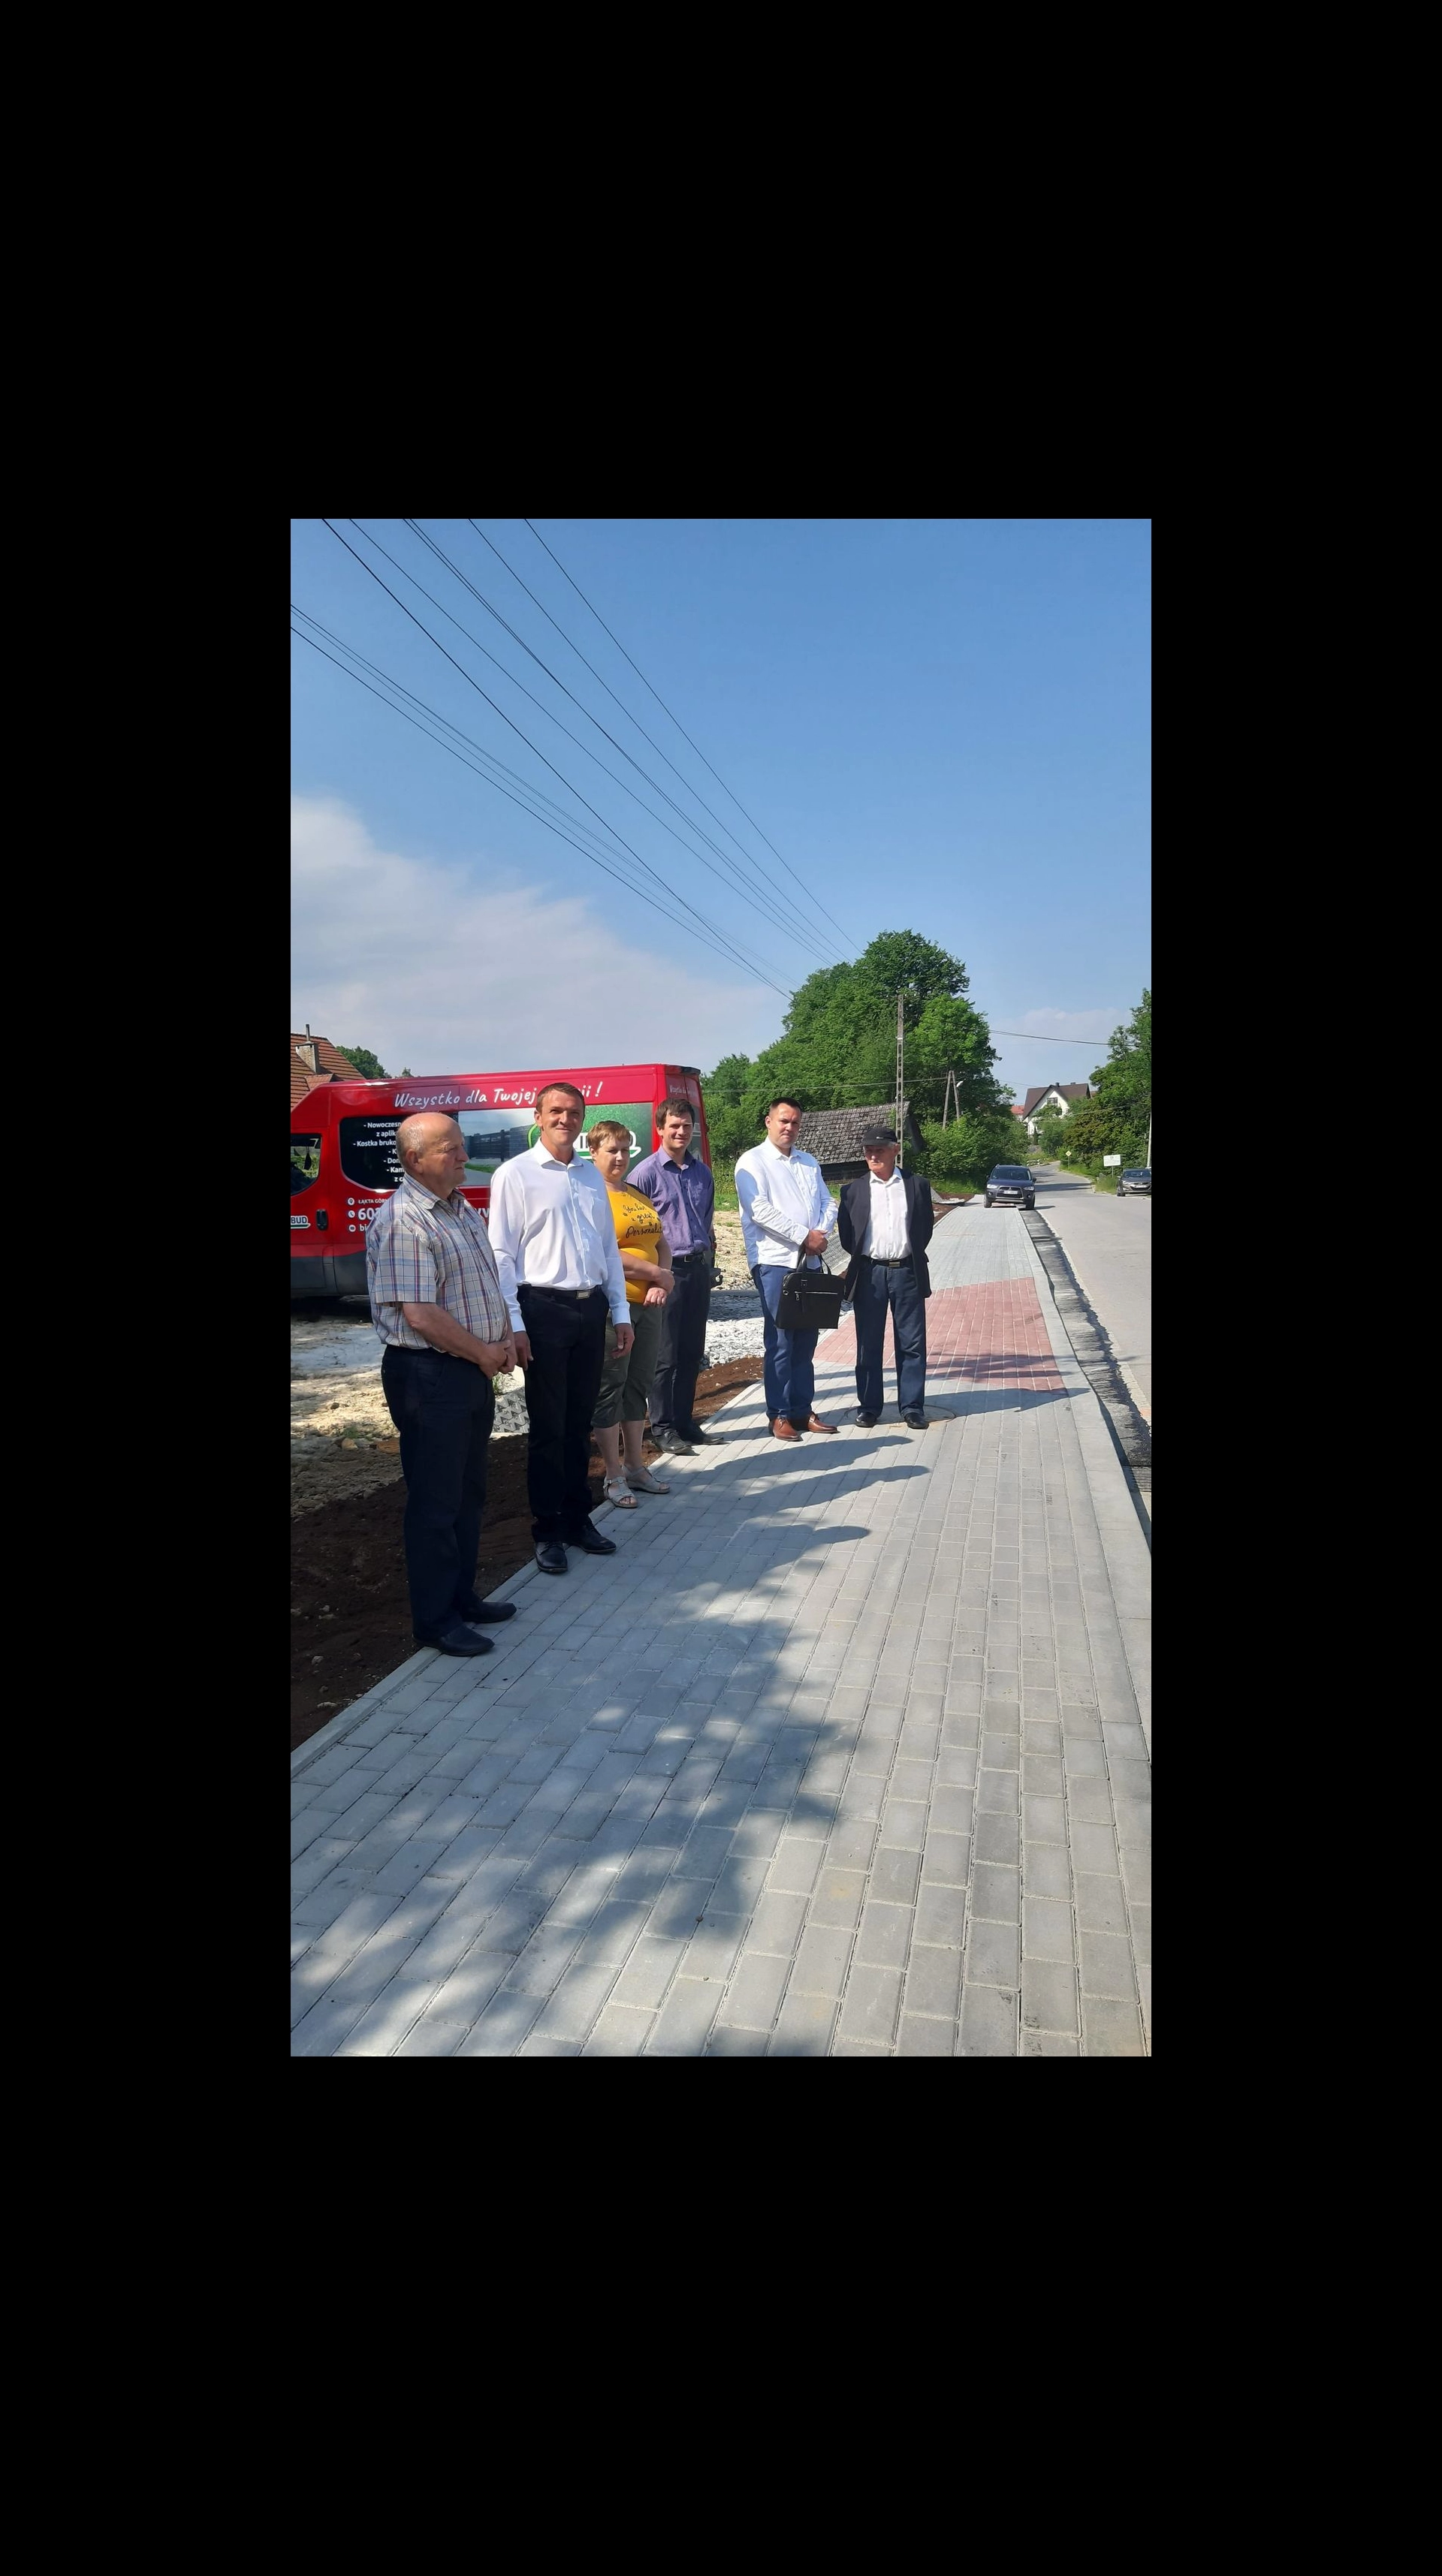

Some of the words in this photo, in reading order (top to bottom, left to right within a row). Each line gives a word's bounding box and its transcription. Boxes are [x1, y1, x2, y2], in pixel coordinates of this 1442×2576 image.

[394, 1091, 460, 1110] Wszystko
[466, 1089, 487, 1103] dla
[493, 1088, 537, 1104] Twojej
[358, 1207, 379, 1221] 60
